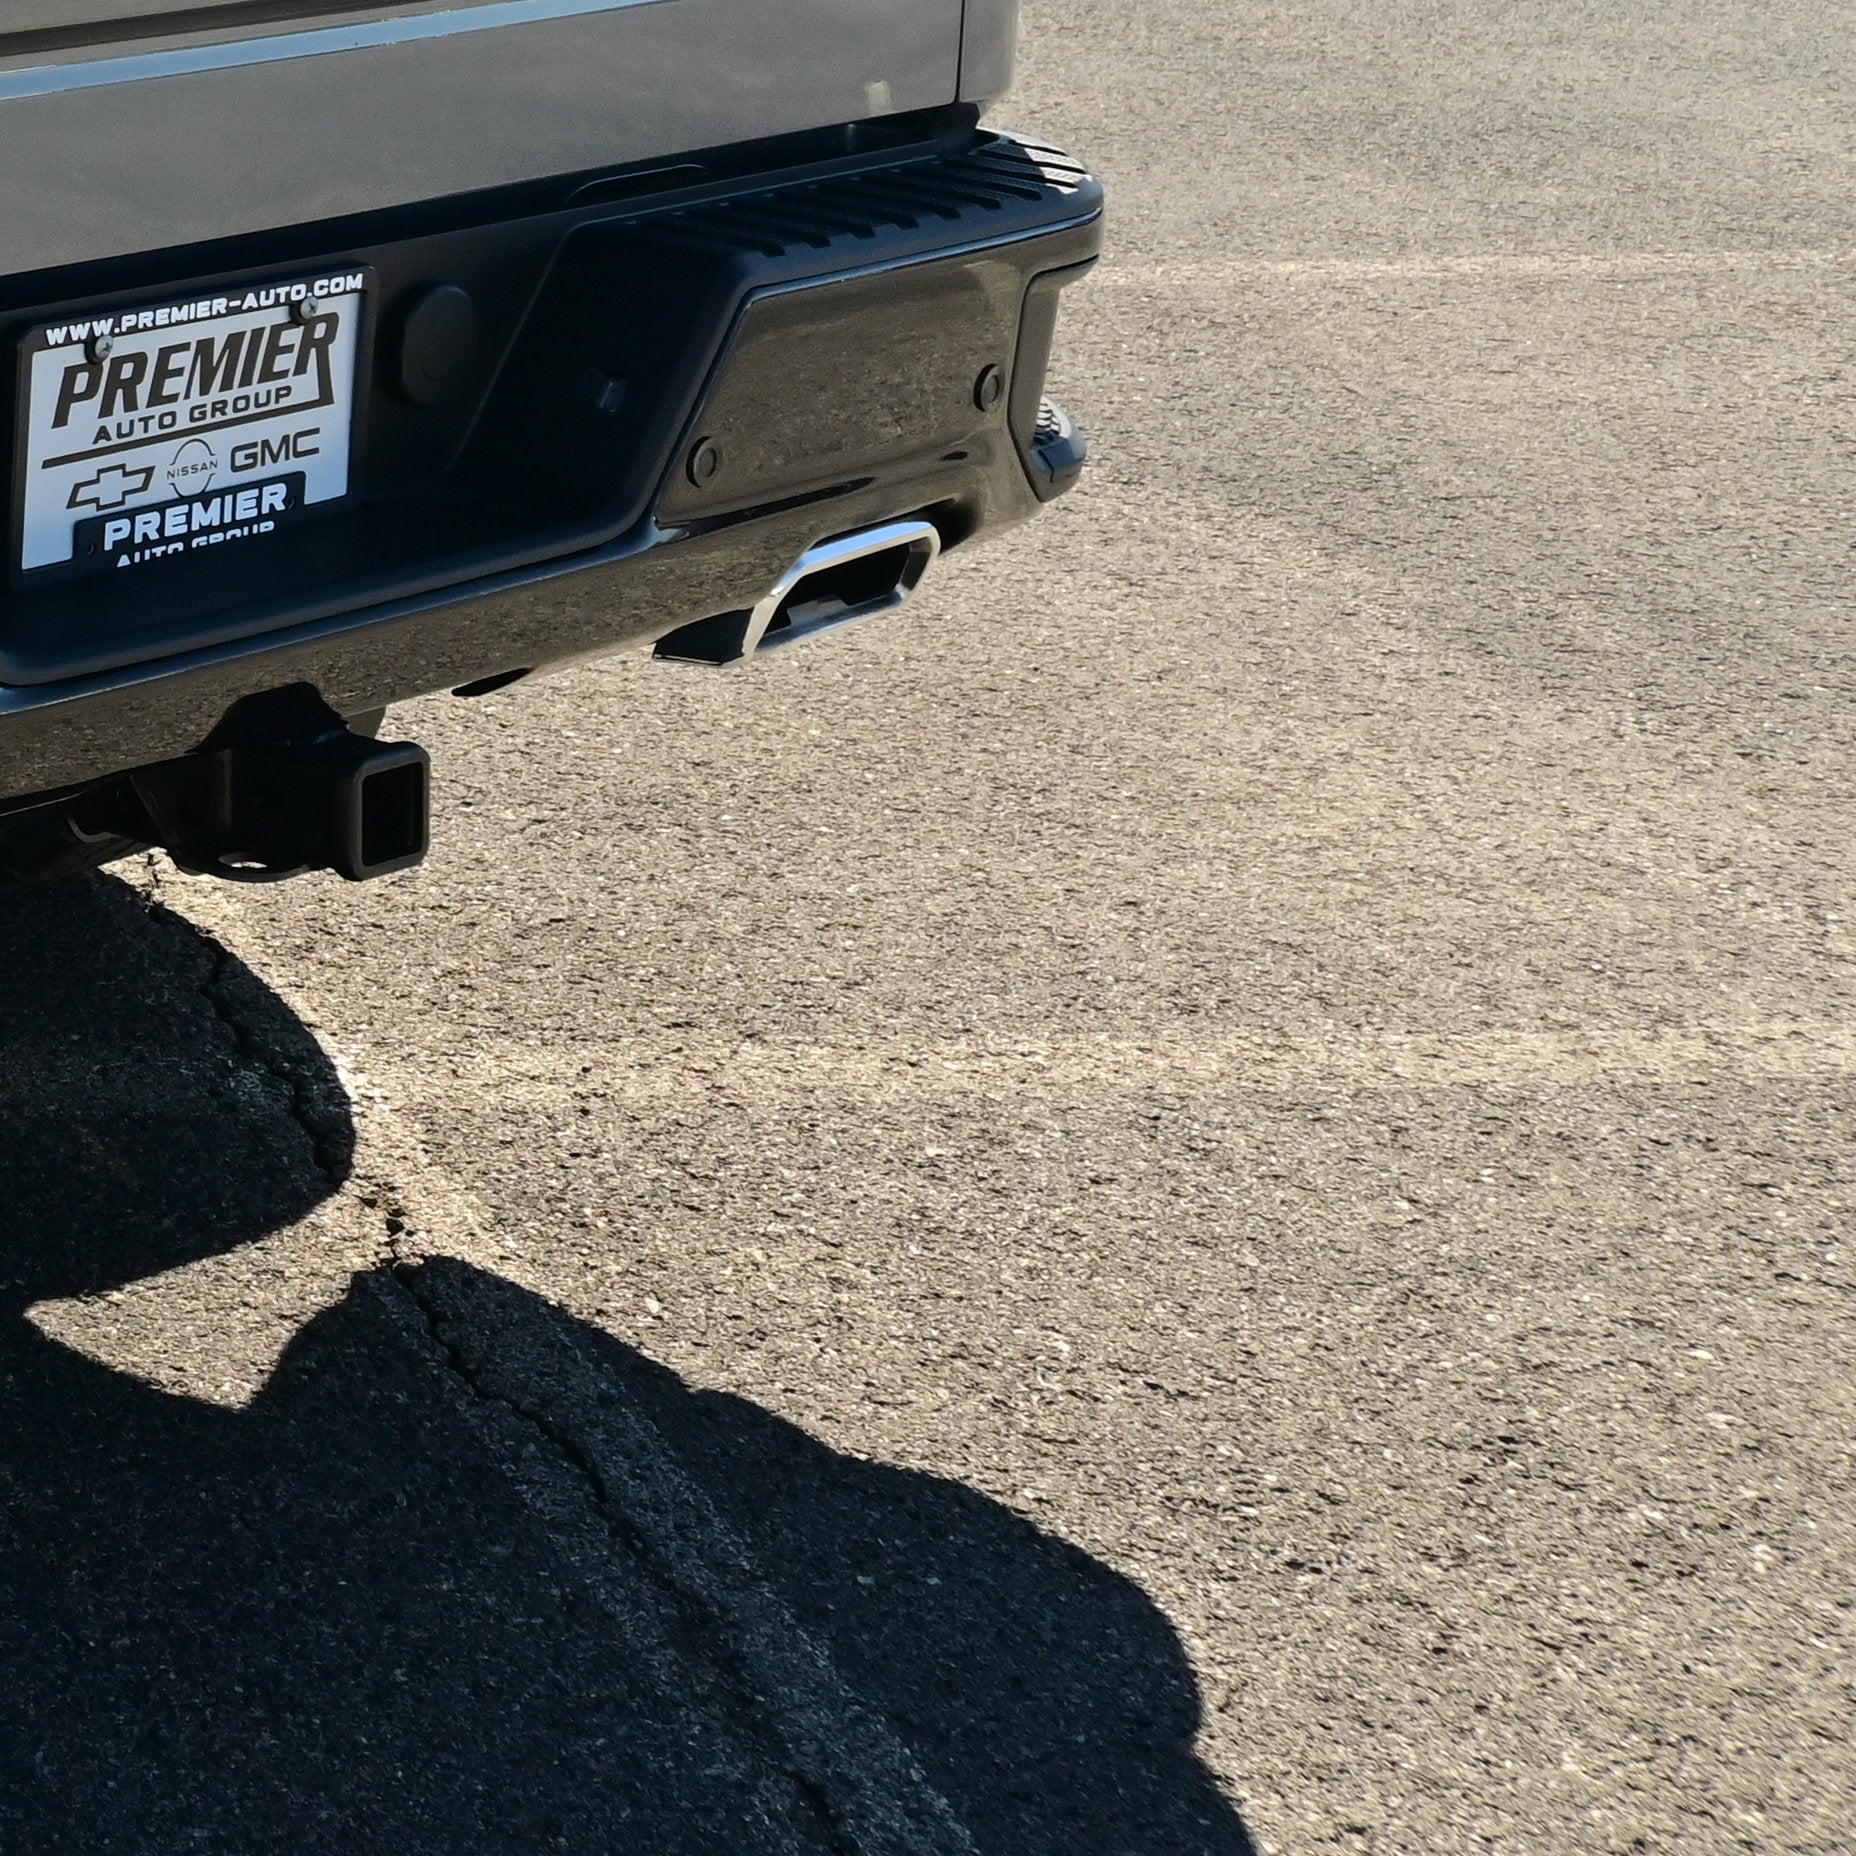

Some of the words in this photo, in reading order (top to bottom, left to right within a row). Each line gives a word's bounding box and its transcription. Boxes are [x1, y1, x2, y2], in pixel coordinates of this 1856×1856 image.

[45, 273, 364, 346] WWW.PREMIER-AUTO.COM
[51, 312, 340, 430] PREMIER
[92, 410, 177, 445] AUTO
[189, 385, 293, 424] GROUP
[166, 459, 218, 480] NISSAN
[230, 427, 321, 473] GMC
[103, 482, 287, 551] PREMIER
